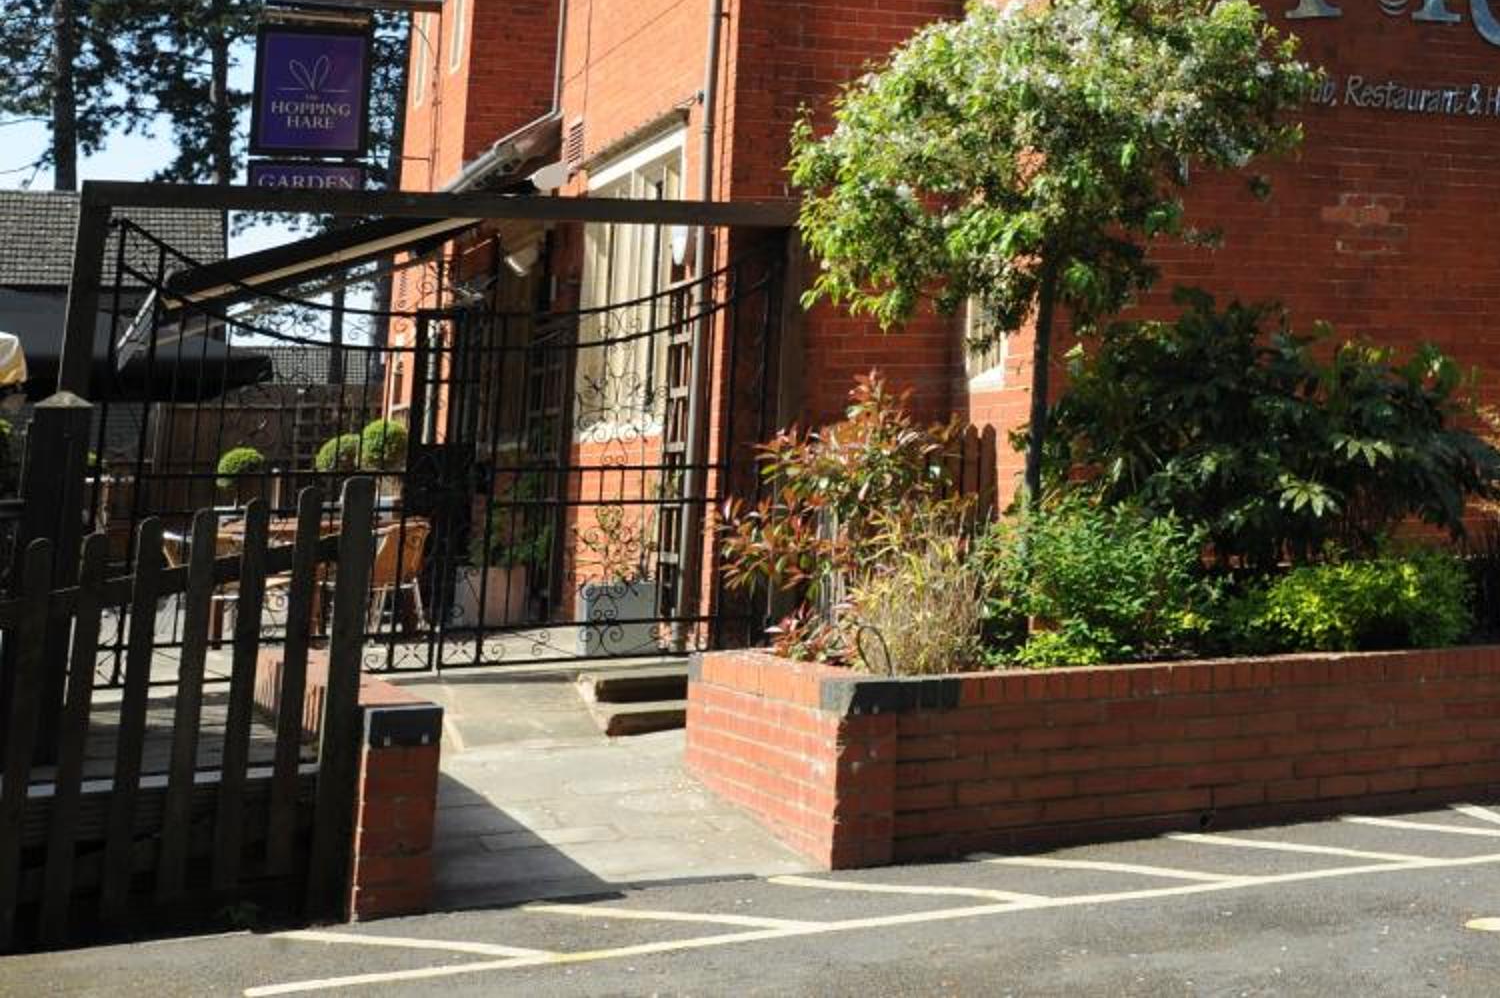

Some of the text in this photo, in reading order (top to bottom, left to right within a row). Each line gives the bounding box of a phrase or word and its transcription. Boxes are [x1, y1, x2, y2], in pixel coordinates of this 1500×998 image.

[1344, 74, 1465, 116] Restaurant
[1467, 83, 1483, 115] &
[271, 101, 351, 117] HOPPING
[287, 116, 336, 129] HARE
